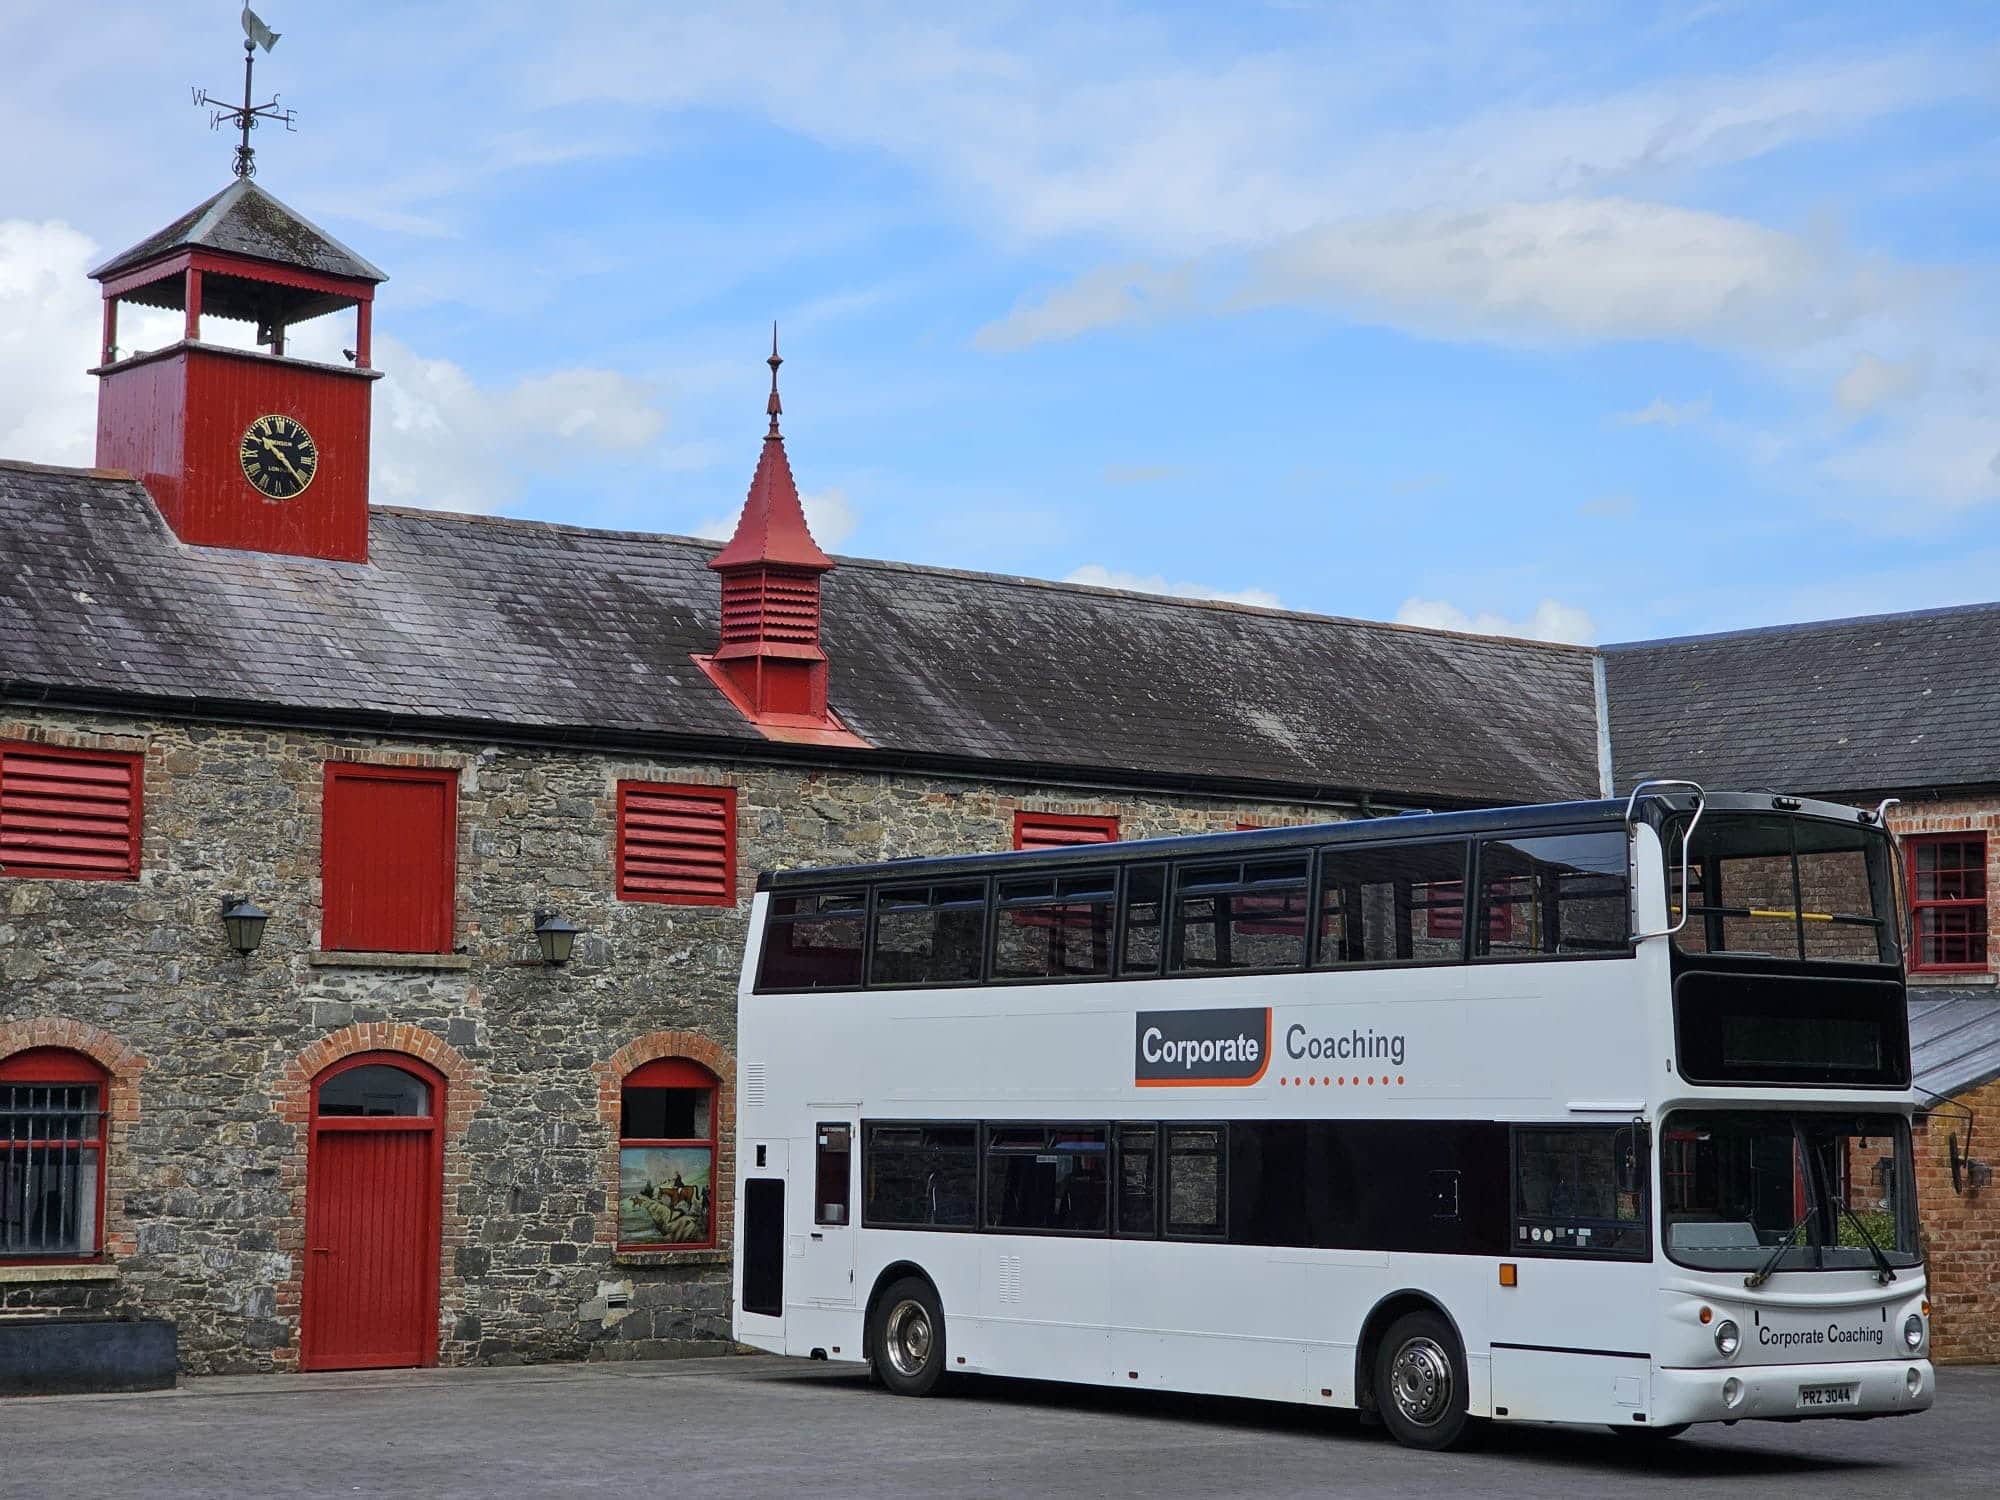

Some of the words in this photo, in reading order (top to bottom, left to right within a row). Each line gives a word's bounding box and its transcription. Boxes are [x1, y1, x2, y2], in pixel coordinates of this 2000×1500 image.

[191, 86, 207, 107] W
[272, 93, 281, 114] S
[286, 109, 298, 132] E
[1142, 1027, 1259, 1069] Corporate
[1286, 1023, 1406, 1066] Coaching
[1759, 1326, 1824, 1348] Corporate
[1828, 1324, 1883, 1345] Coaching
[1802, 1390, 1822, 1405] PRZ
[1825, 1389, 1850, 1403] 3044
